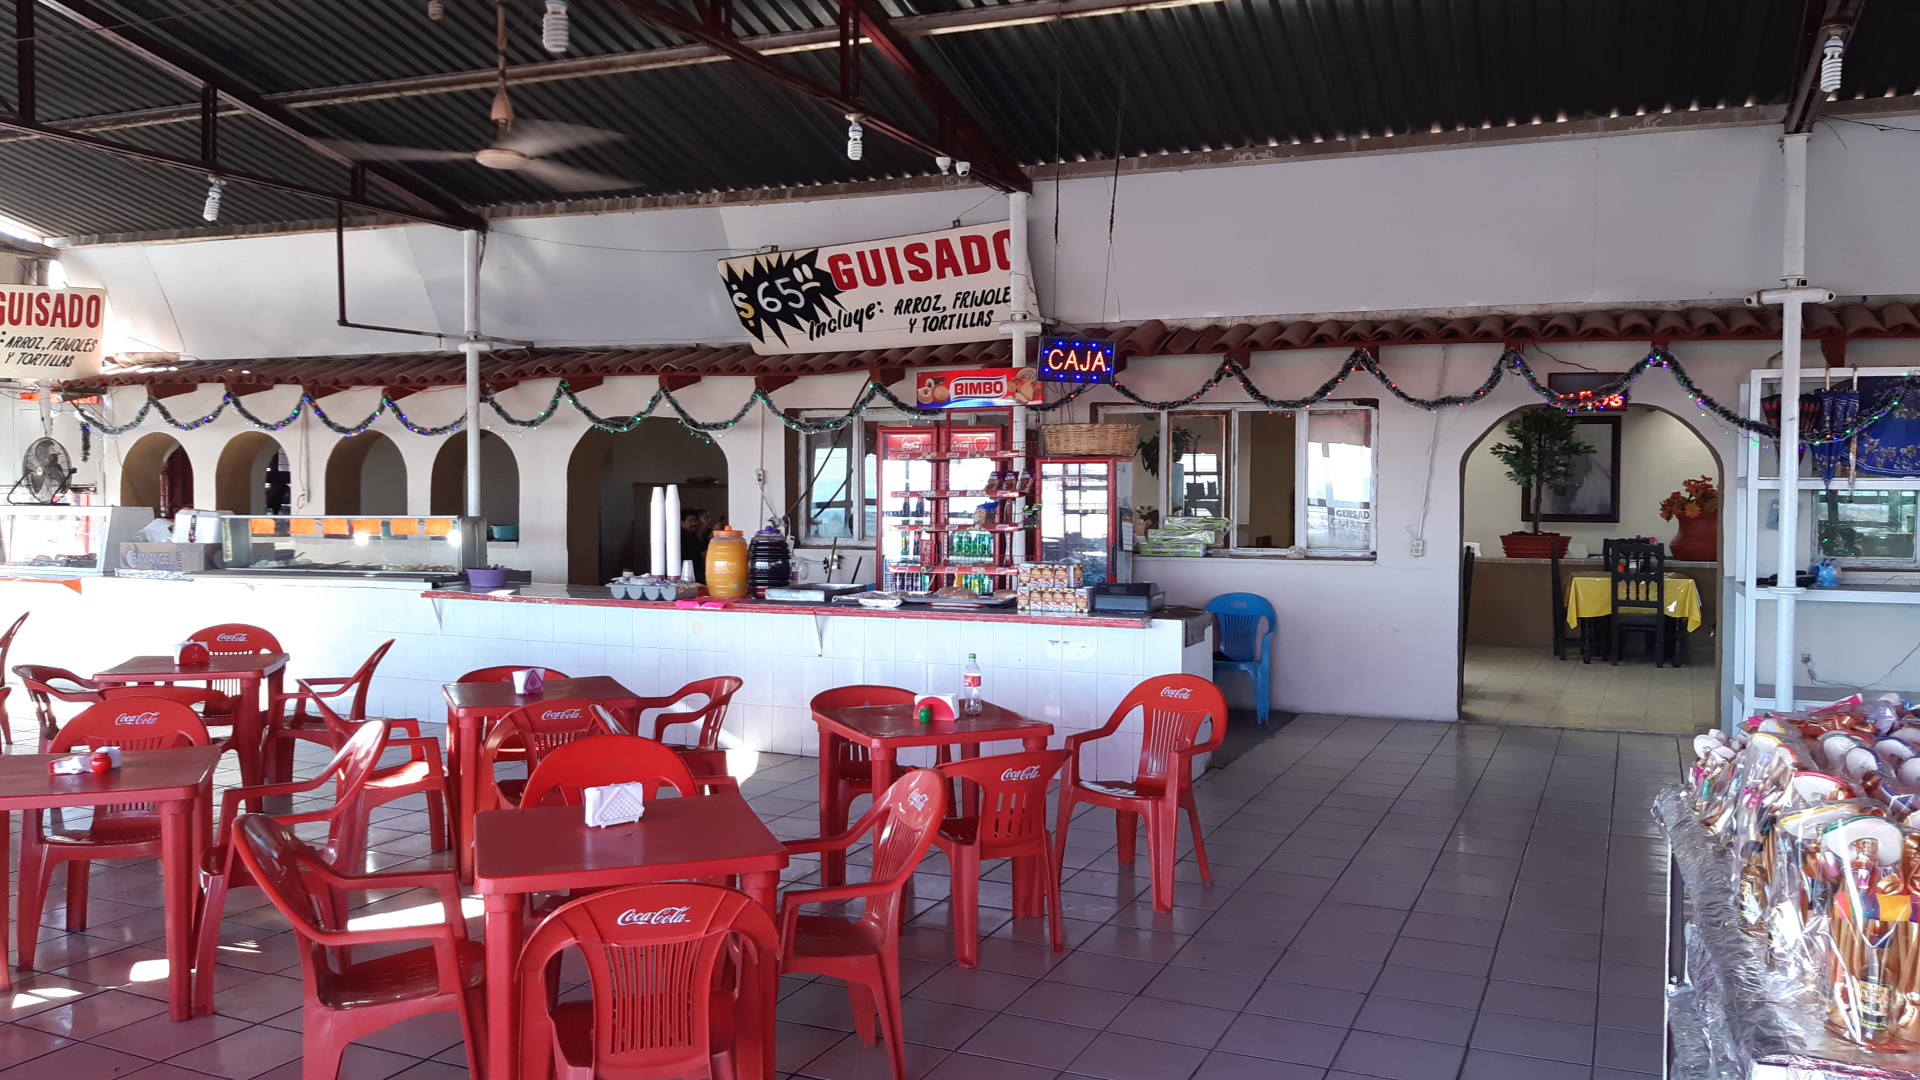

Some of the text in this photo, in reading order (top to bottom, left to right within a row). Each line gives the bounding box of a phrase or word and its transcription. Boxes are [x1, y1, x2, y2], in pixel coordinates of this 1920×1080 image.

[808, 286, 1011, 341] Incluye: ARROZ, FRIJOLE
[908, 310, 995, 333] Y TORTILLAS
[4, 336, 46, 351] ARROZ,
[46, 337, 98, 353] FRIJOLES
[4, 351, 75, 368] Y TORTILLAS
[1048, 349, 1107, 372] CAJA
[954, 381, 1004, 396] BIMBO
[114, 711, 160, 726] Coca-Cola
[541, 708, 583, 721] Coca-Cola
[1000, 764, 1041, 782] Coca-Cola
[616, 906, 691, 926] Coca-Cola
